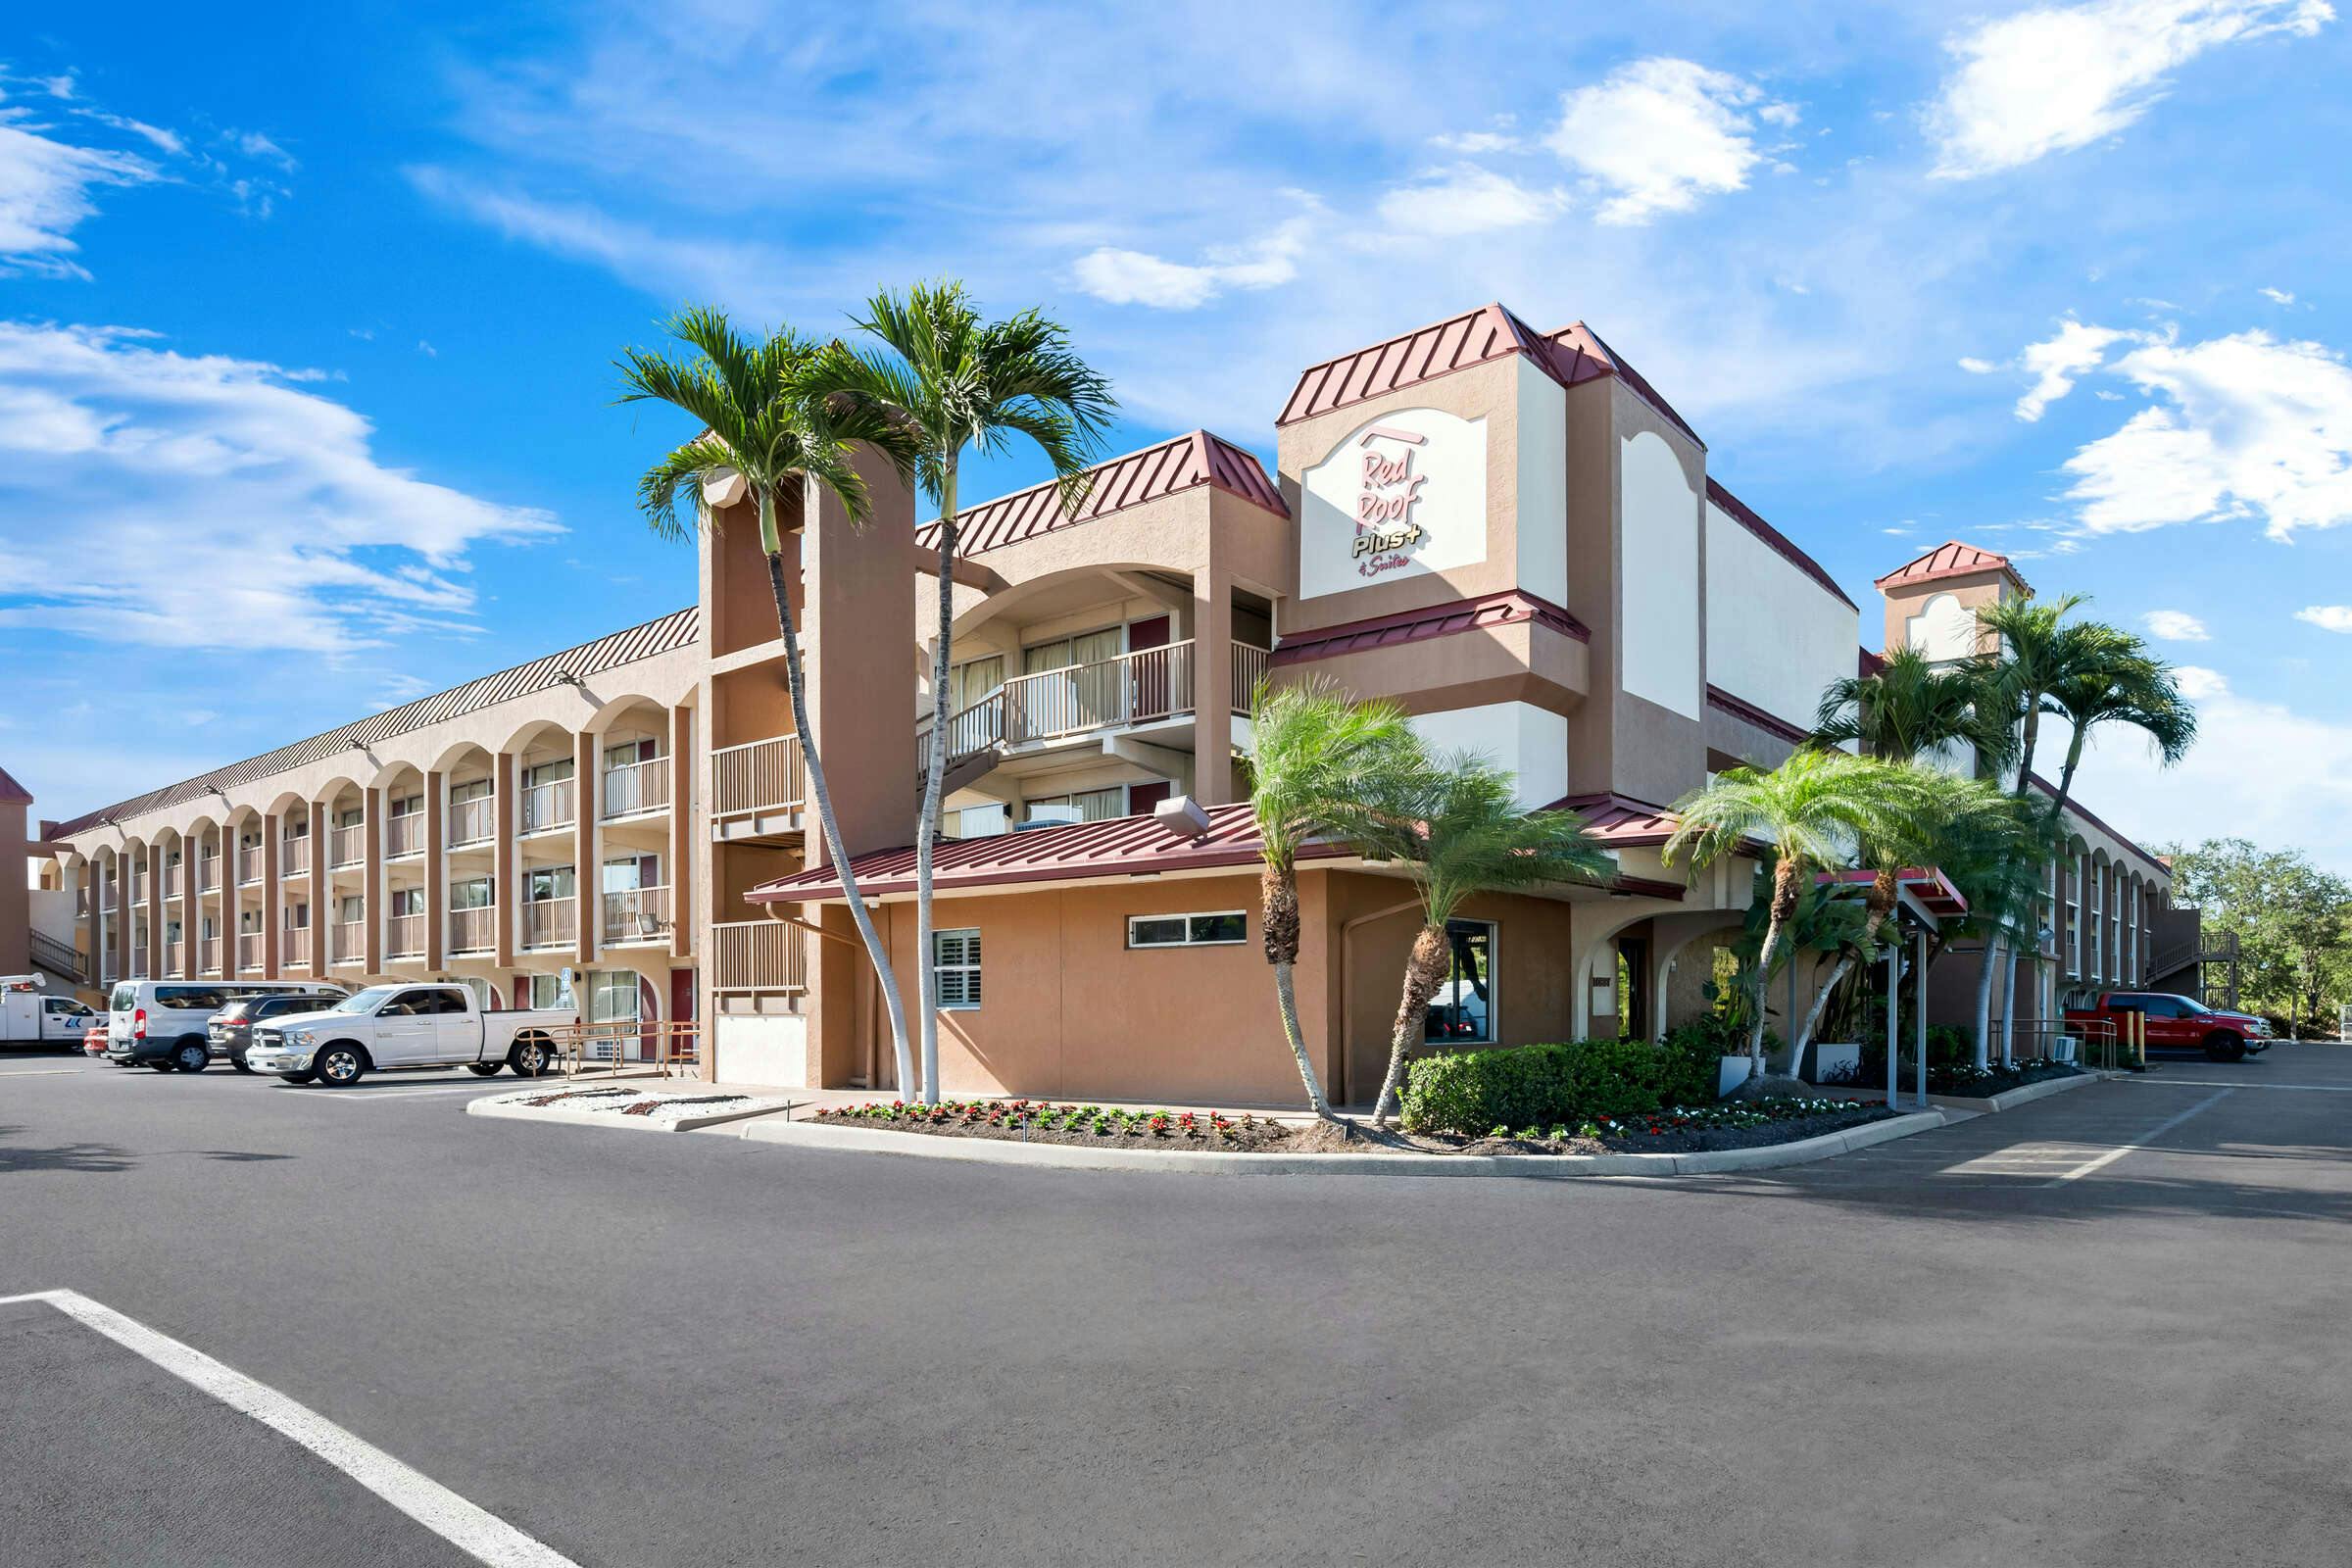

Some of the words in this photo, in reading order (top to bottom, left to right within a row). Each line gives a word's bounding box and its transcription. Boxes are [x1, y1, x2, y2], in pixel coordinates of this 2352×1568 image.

[1362, 448, 1411, 489] Red
[1356, 474, 1425, 535] Roof
[1351, 523, 1422, 559] Plus+
[1358, 562, 1367, 576] &
[1367, 554, 1410, 577] Suites
